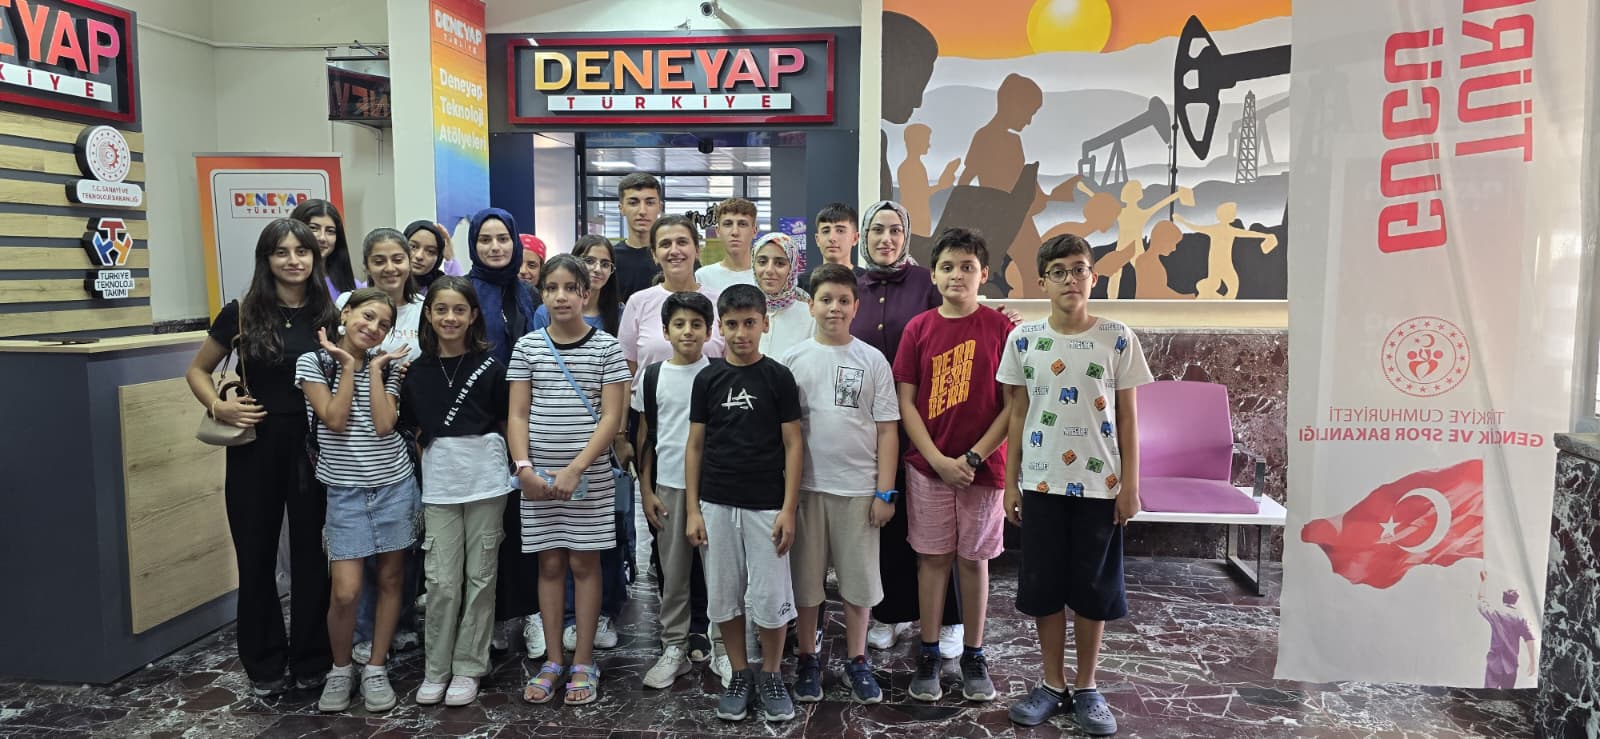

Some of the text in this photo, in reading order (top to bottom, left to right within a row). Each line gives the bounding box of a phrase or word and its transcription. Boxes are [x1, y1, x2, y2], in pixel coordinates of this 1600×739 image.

[435, 8, 482, 46] DENEYAP
[439, 67, 483, 102] Deneyap
[534, 47, 805, 91] DENEYAP
[439, 95, 484, 127] Teknoloji
[567, 94, 771, 110] TÜRKİYE
[234, 192, 307, 207] DENEYAP
[444, 406, 460, 427] FEEL
[455, 387, 469, 405] THE
